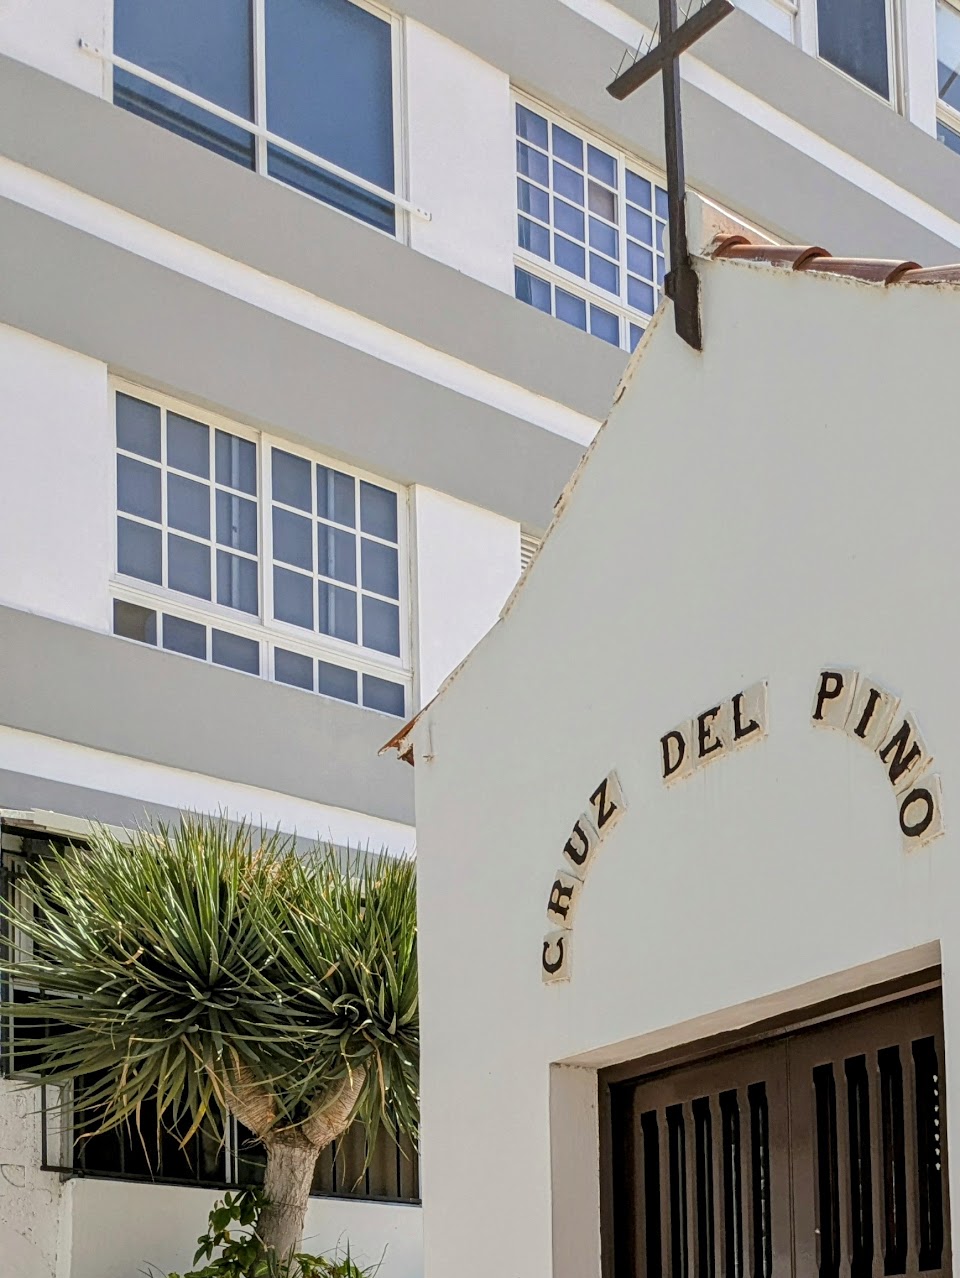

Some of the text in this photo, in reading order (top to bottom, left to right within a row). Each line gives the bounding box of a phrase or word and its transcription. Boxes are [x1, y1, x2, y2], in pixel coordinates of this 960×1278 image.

[542, 671, 934, 974] CRUZ DEL PINO
